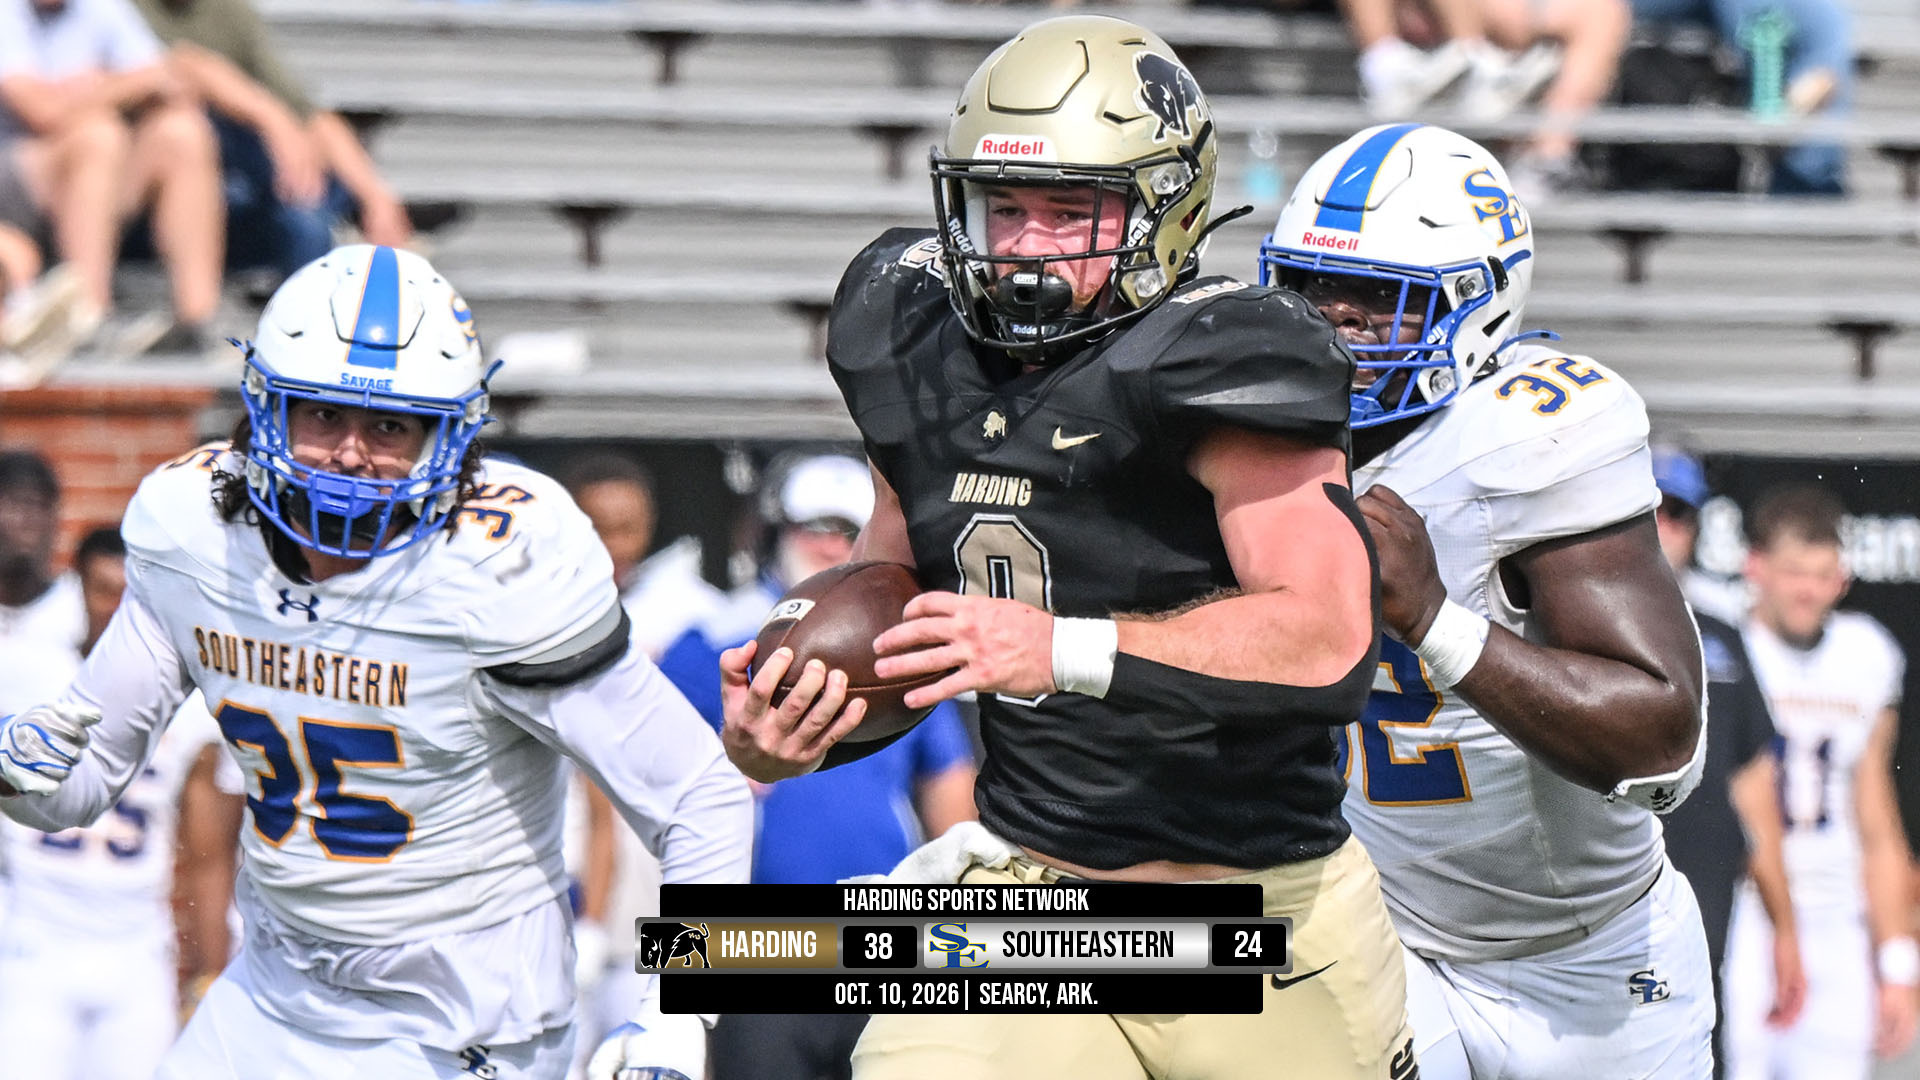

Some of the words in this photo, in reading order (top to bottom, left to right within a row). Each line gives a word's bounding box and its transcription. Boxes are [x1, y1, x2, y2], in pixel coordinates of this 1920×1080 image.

[982, 139, 1043, 155] Riddell
[1462, 168, 1529, 246] SE
[1302, 231, 1359, 251] Riddell
[1495, 357, 1610, 416] 32
[950, 472, 1032, 507] HARDING
[194, 626, 409, 707] SOUTHEASTERN
[1338, 632, 1473, 807] 2
[214, 698, 415, 863] 35
[1628, 968, 1670, 1005] SE
